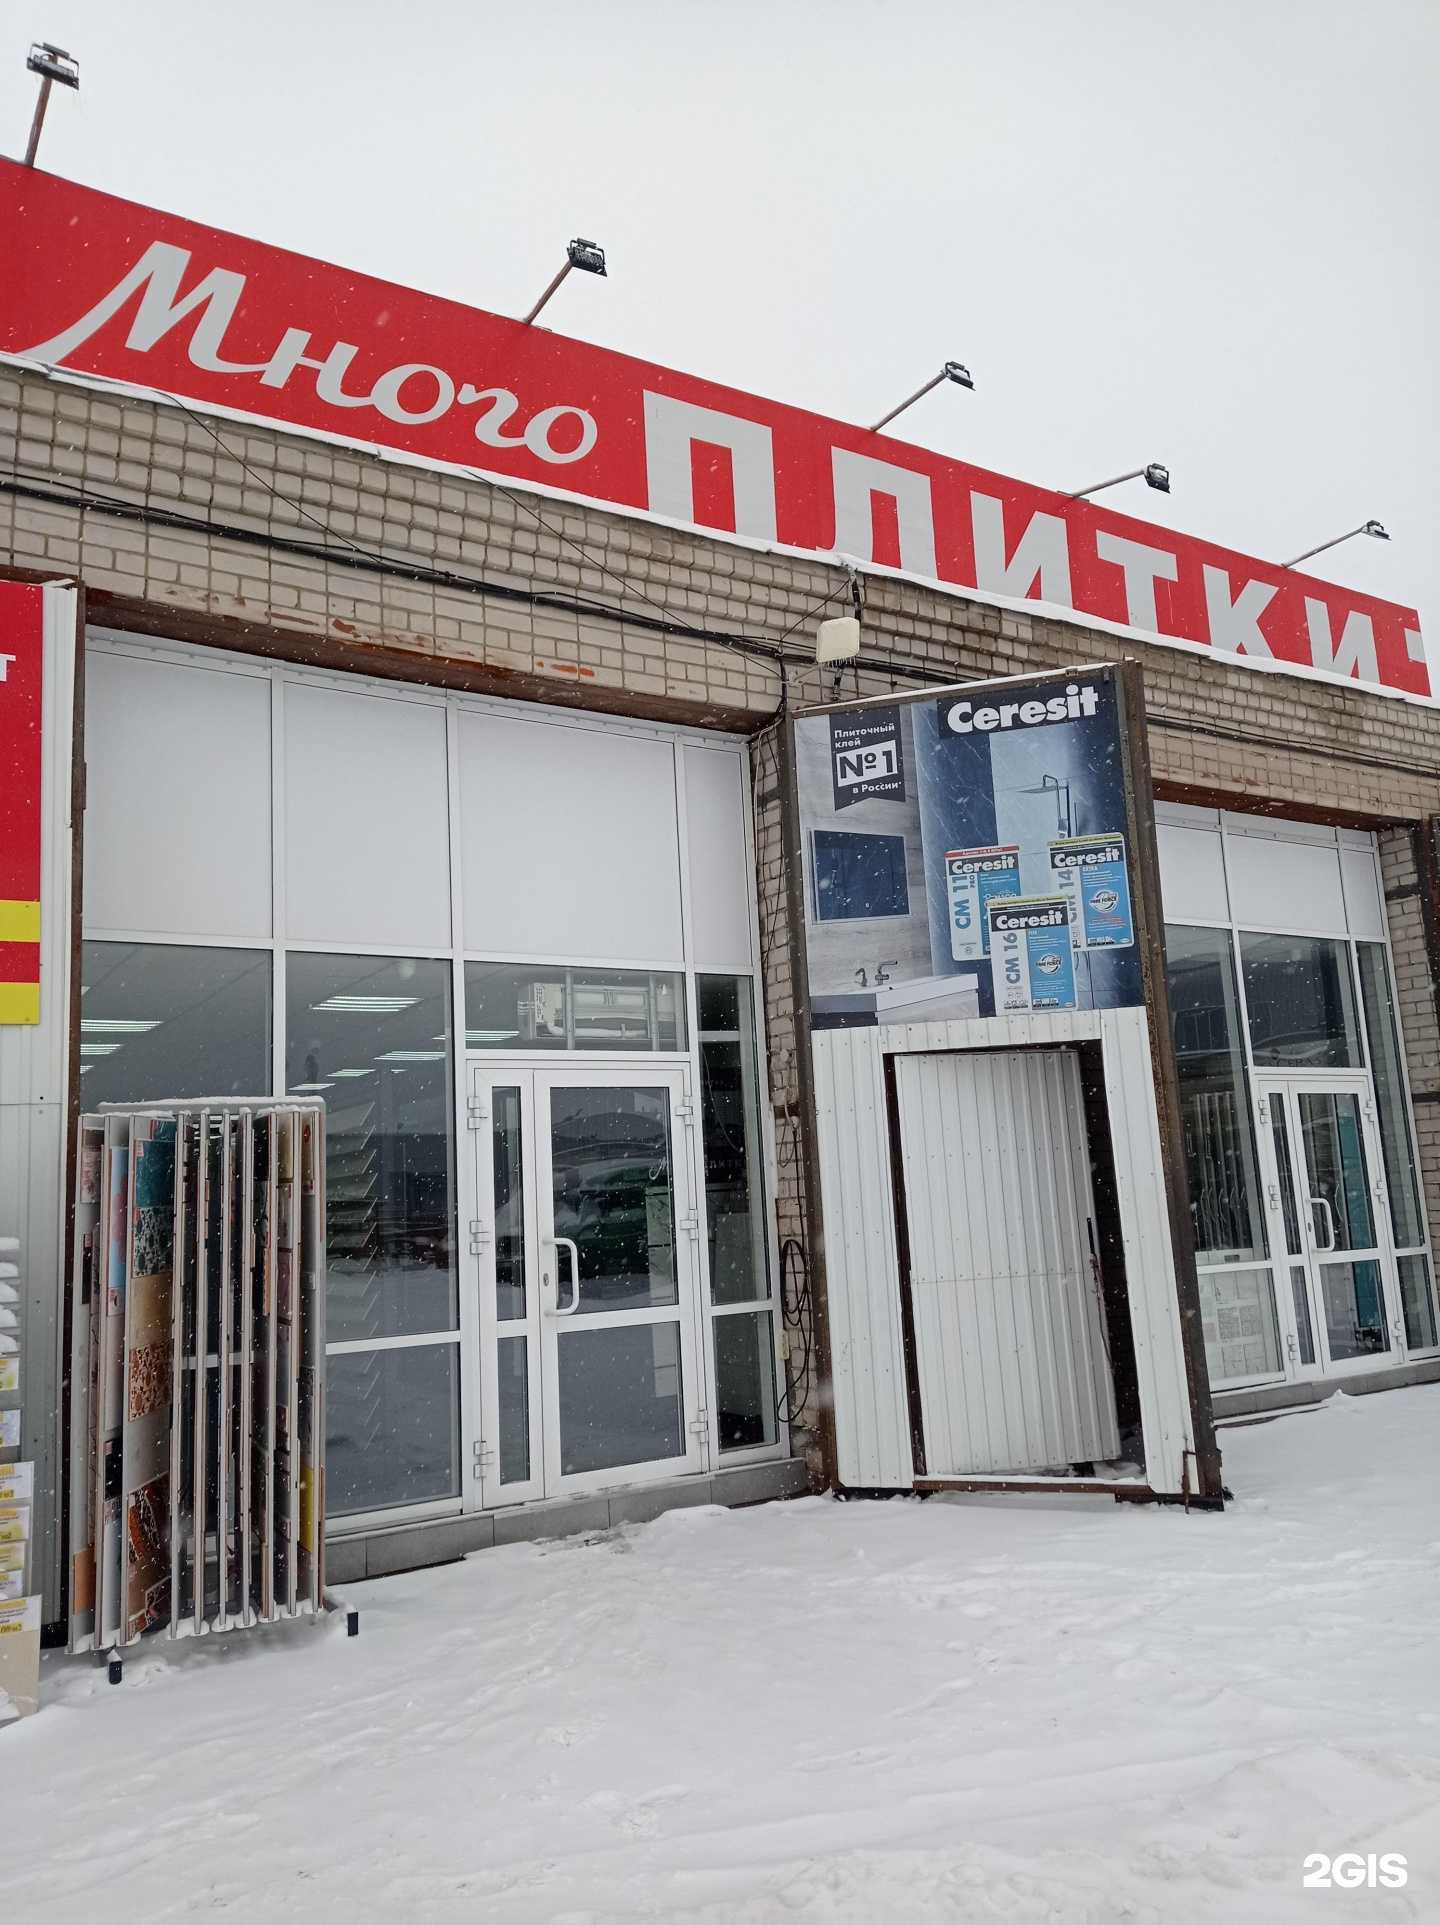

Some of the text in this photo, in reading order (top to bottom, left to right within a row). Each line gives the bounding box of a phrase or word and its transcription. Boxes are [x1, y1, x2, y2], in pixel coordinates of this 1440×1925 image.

[18, 240, 597, 464] Много
[643, 390, 1381, 684] ПЛИТКИ
[947, 685, 1098, 734] Ceresit
[834, 721, 895, 739] Плиточный
[835, 737, 861, 749] клей
[951, 855, 1015, 875] Ceresit
[1054, 847, 1120, 867] Ceresit
[996, 909, 1063, 930] Ceresit
